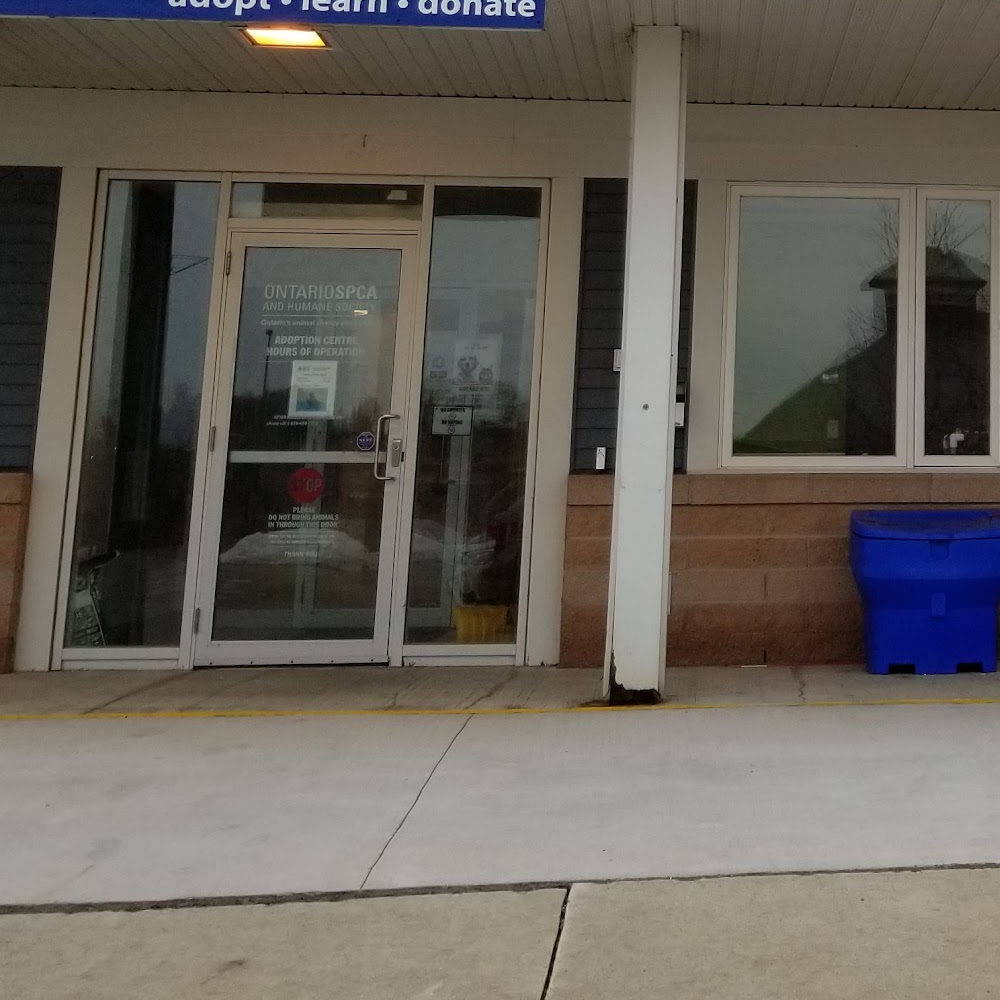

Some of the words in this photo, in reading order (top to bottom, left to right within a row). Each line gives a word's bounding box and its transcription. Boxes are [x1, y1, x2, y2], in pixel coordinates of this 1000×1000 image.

[262, 302, 284, 311] AND
[287, 302, 332, 312] HUMANE
[274, 335, 320, 345] ADOPTION
[266, 347, 297, 356] HOURS
[300, 347, 311, 356] OF
